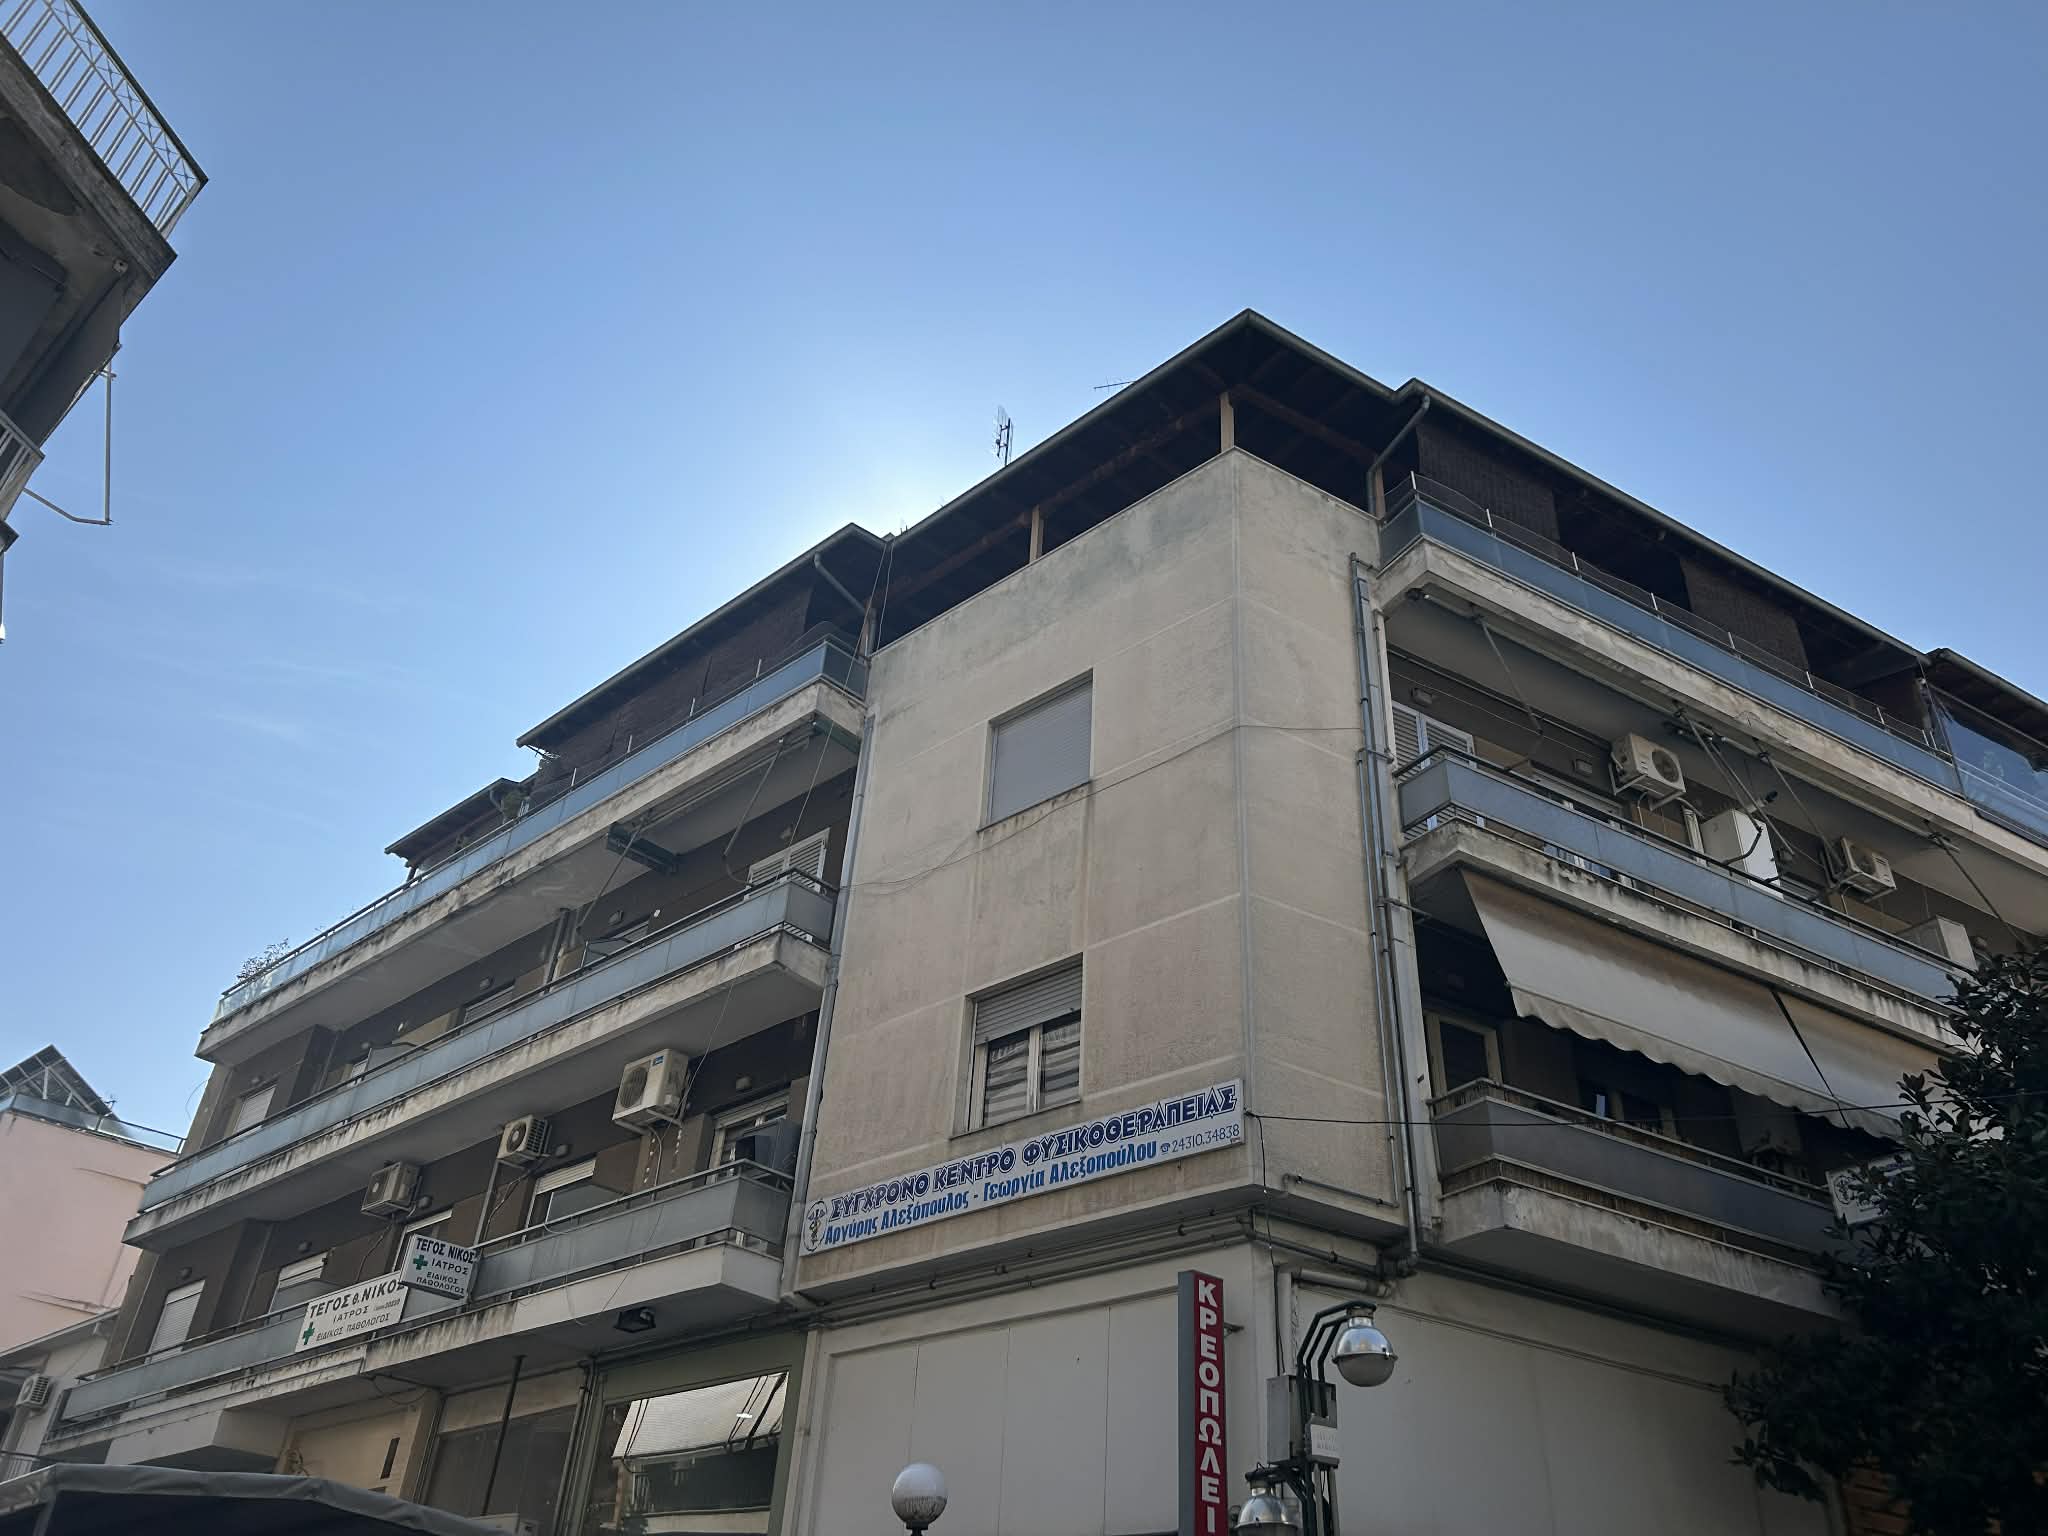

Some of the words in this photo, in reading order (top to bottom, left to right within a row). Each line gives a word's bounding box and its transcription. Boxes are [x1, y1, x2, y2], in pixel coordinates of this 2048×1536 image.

[828, 1172, 930, 1222] ΣΥΓΧΡΟΝΟ
[932, 1147, 1016, 1192] ΚΕΝΤΡΟ
[1022, 1085, 1238, 1166] ΦΥΣΙΚΟΘΕΡΑΠΕΙΑΣ
[824, 1216, 878, 1245] Αργύρης
[881, 1190, 968, 1230] Αλεξόπουλος
[983, 1169, 1045, 1202] Γεωργία
[1050, 1140, 1157, 1185] Αλεξοπούλου
[1172, 1124, 1240, 1153] 24310.34838
[416, 1238, 446, 1255] ΤΕΓΟΣ
[448, 1246, 475, 1264] ΝΙΚΟΣ
[426, 1271, 459, 1284] ΕΙΔΙΚΟΣ
[431, 1258, 469, 1275] ΙΑΤΡΟΣ
[416, 1276, 464, 1294] ΠΑΘΟΛΟΓΟΣ
[310, 1293, 351, 1318] ΤΕΓΟΣ
[333, 1305, 369, 1324] ΙΑΤΡΟΣ
[316, 1326, 344, 1341] ΕΙΔΙΚΟΣ
[346, 1313, 390, 1333] ΠΑΘΟΛΟΓΟΣ
